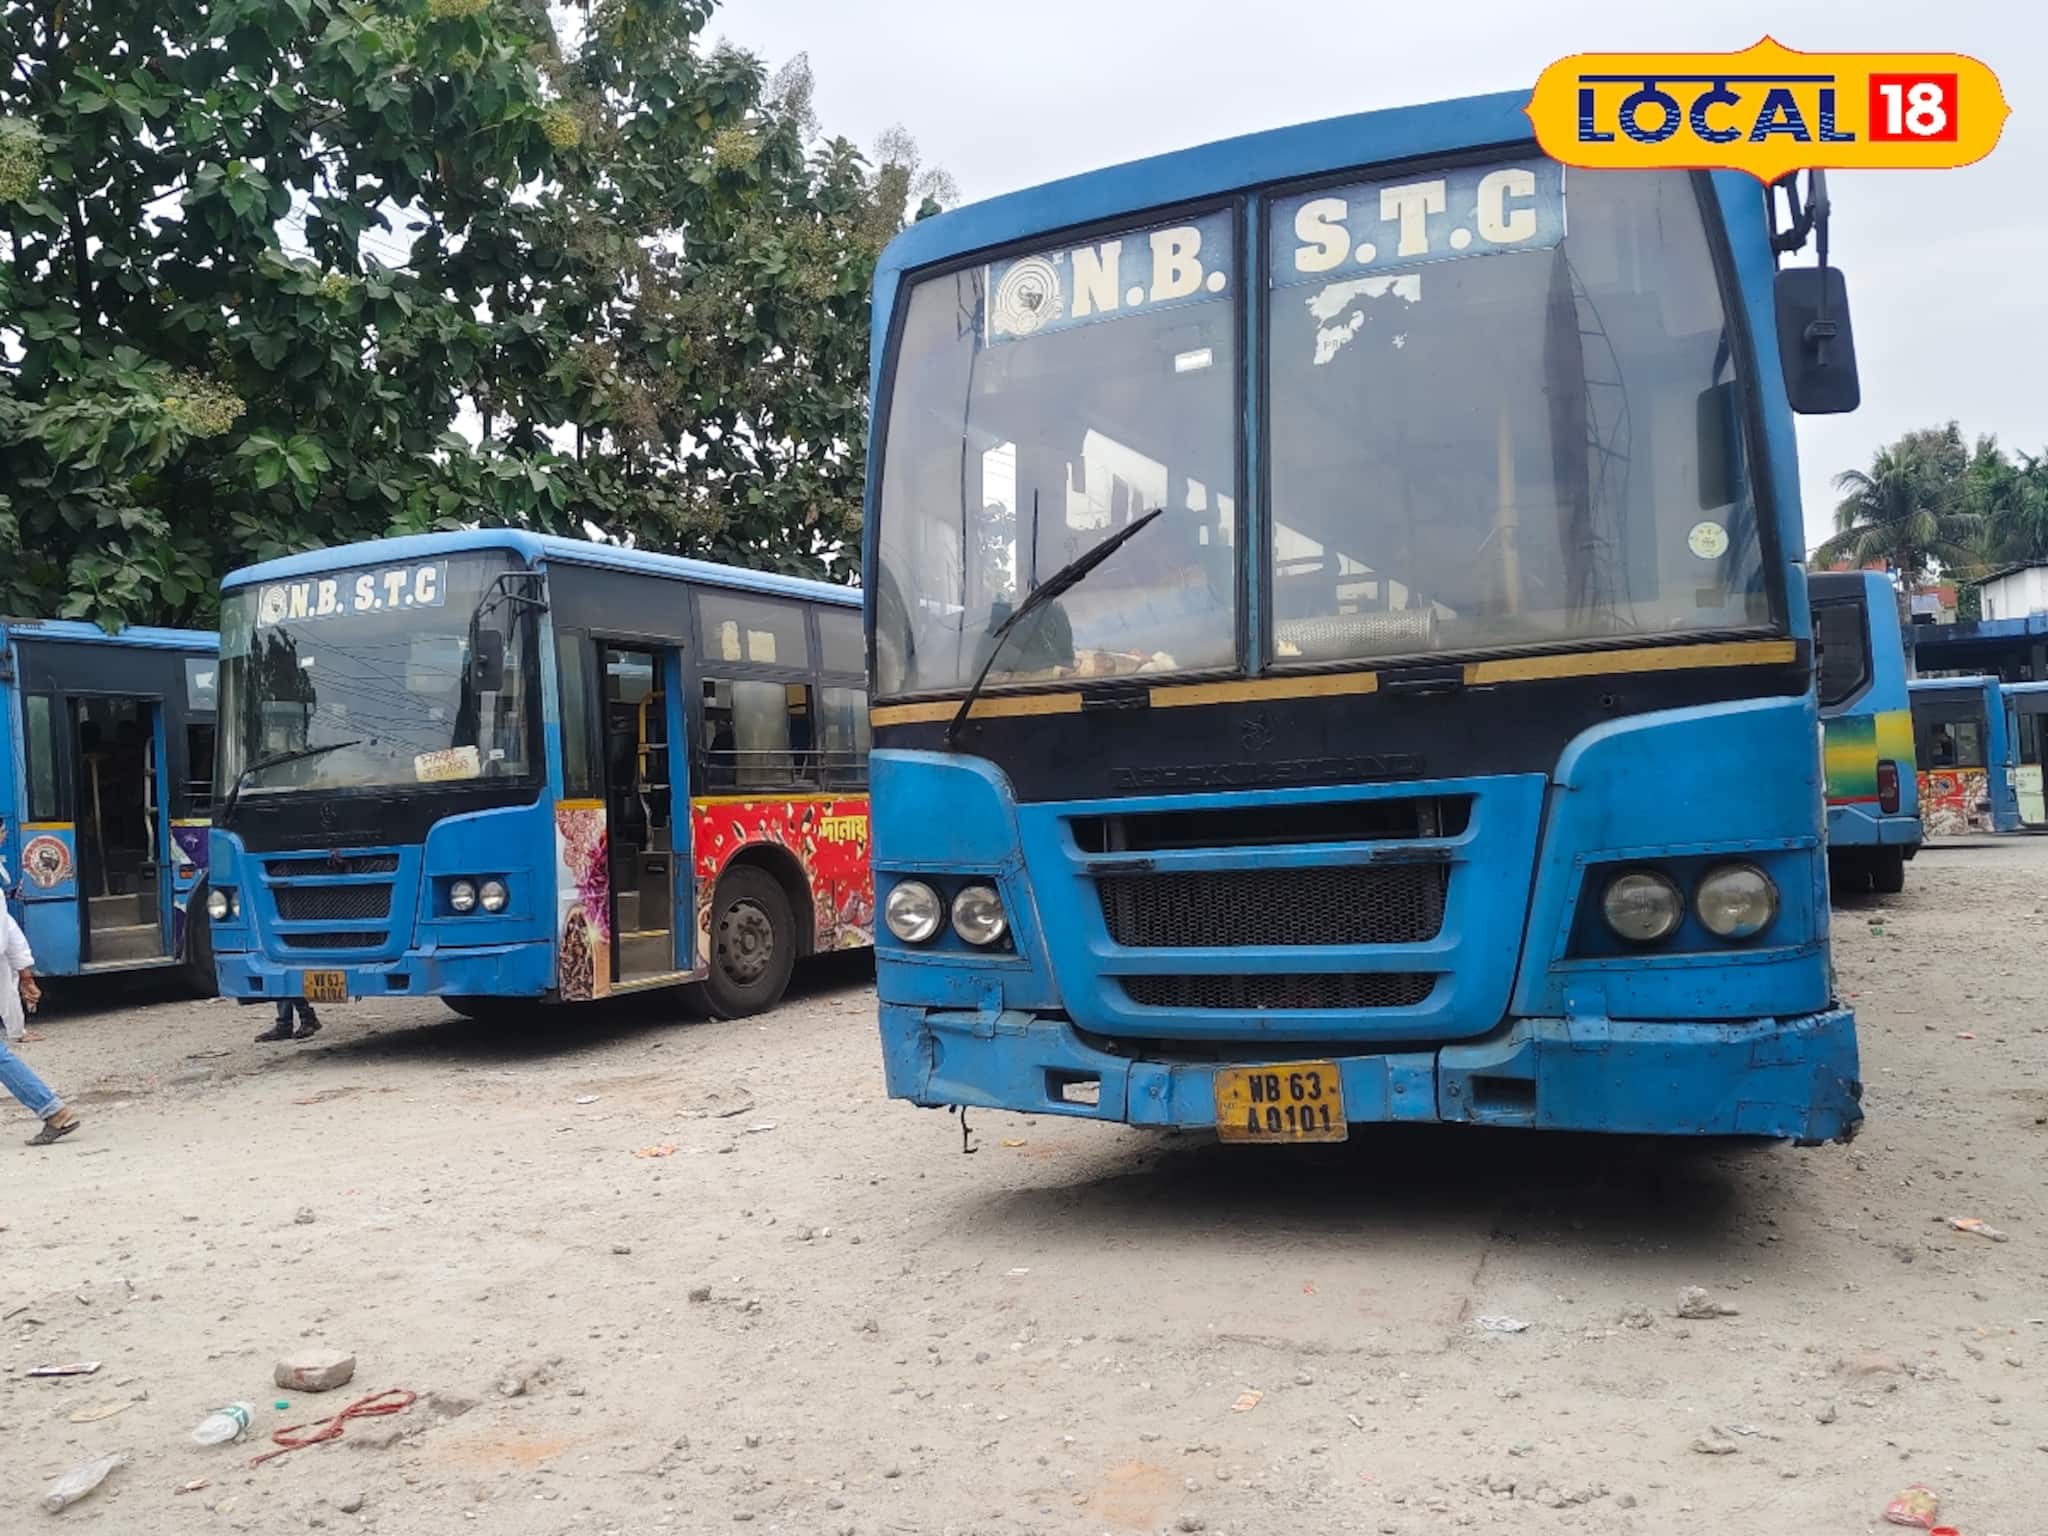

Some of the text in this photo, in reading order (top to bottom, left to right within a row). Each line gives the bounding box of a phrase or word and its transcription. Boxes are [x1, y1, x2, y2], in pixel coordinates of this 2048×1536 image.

[1070, 167, 1538, 319] N.B. S.T.C
[288, 566, 436, 619] N.B. S.T.C
[1248, 1071, 1322, 1103] WB 63
[1247, 1104, 1331, 1134] A0101
